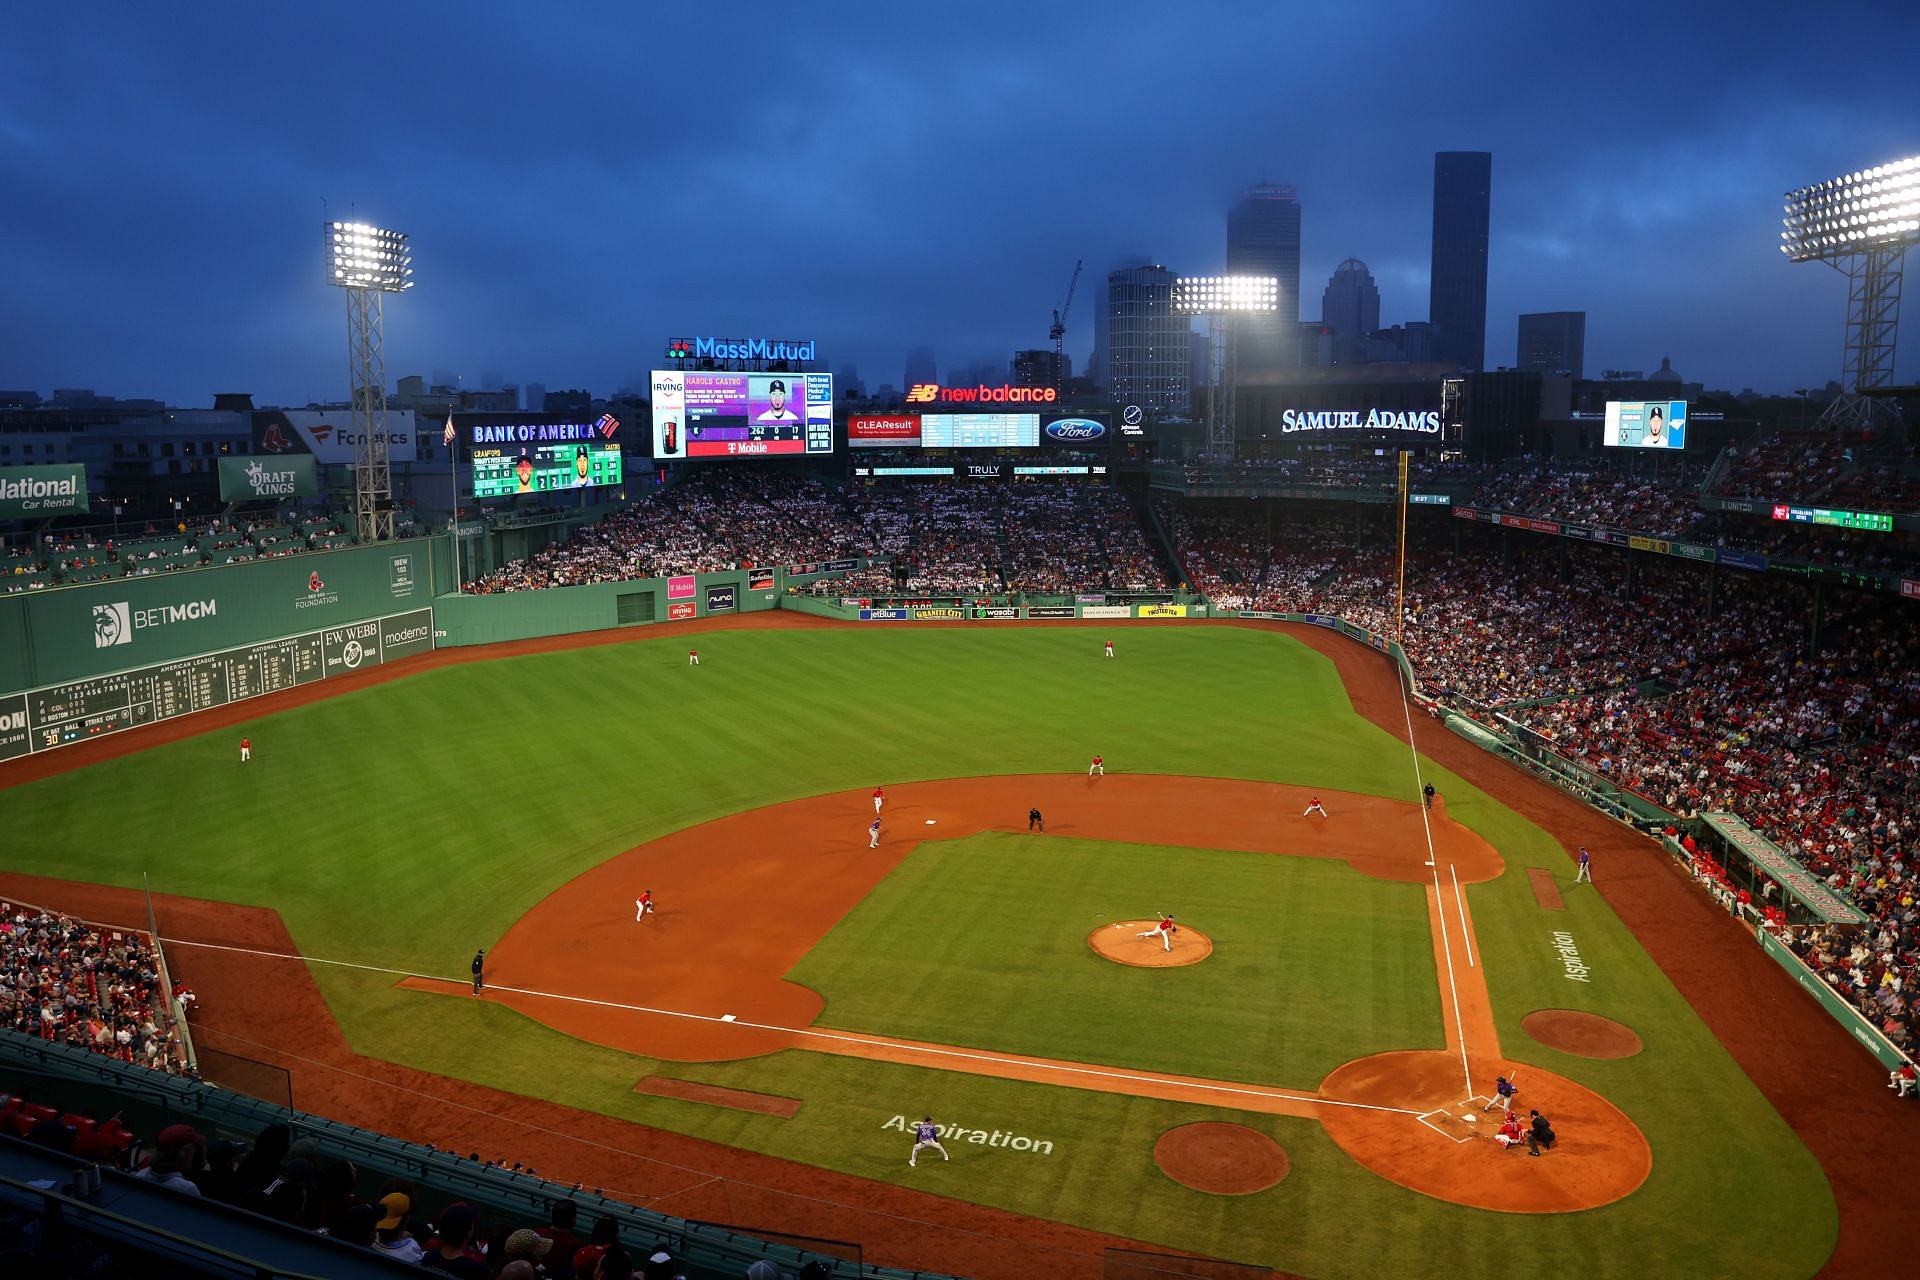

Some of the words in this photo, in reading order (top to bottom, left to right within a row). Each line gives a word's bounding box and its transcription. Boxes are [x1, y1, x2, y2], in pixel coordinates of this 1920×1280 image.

[695, 336, 815, 361] MassMutual
[654, 384, 683, 392] IRVING
[941, 386, 977, 402] new
[980, 384, 1056, 402] balance
[856, 420, 912, 430] CLEAResult
[1282, 408, 1362, 432] SAMUEL
[1364, 408, 1440, 433] ADAMS
[473, 426, 516, 442] BANK
[518, 426, 536, 442] OF
[538, 424, 596, 440] AMERICA
[750, 427, 764, 435] .262
[792, 426, 798, 434] 17
[1058, 422, 1093, 438] Ford
[738, 442, 768, 454] Mobile
[968, 466, 1000, 474] TRULY
[250, 470, 296, 486] DRAFT
[540, 478, 545, 488] 2
[552, 477, 556, 488] 2
[255, 483, 295, 496] KINGS
[22, 501, 40, 509] Car
[43, 498, 75, 508] Rental
[1728, 504, 1752, 512] UNITED
[397, 566, 406, 574] 103
[295, 596, 338, 609] FOUNDATION
[134, 599, 216, 629] BETMGM
[870, 610, 897, 619] jetBlue
[916, 610, 946, 618] GRANITE
[947, 609, 962, 618] CITY
[986, 608, 1015, 616] wasabi
[1147, 608, 1168, 616] TWISTED
[1169, 608, 1178, 616] TEA
[346, 624, 377, 640] WEBB
[386, 626, 428, 644] moderna
[252, 644, 277, 653] NATIONAL
[161, 662, 191, 672] AMERICAN
[193, 657, 215, 665] LEAGUE
[328, 657, 342, 666] Since
[54, 682, 95, 695] FENWAY
[103, 676, 128, 684] PARK
[48, 712, 68, 721] BOSTON
[65, 723, 79, 731] BALL
[85, 717, 103, 726] STRIKE
[46, 734, 58, 746] 30
[1549, 931, 1591, 983] Aspiration
